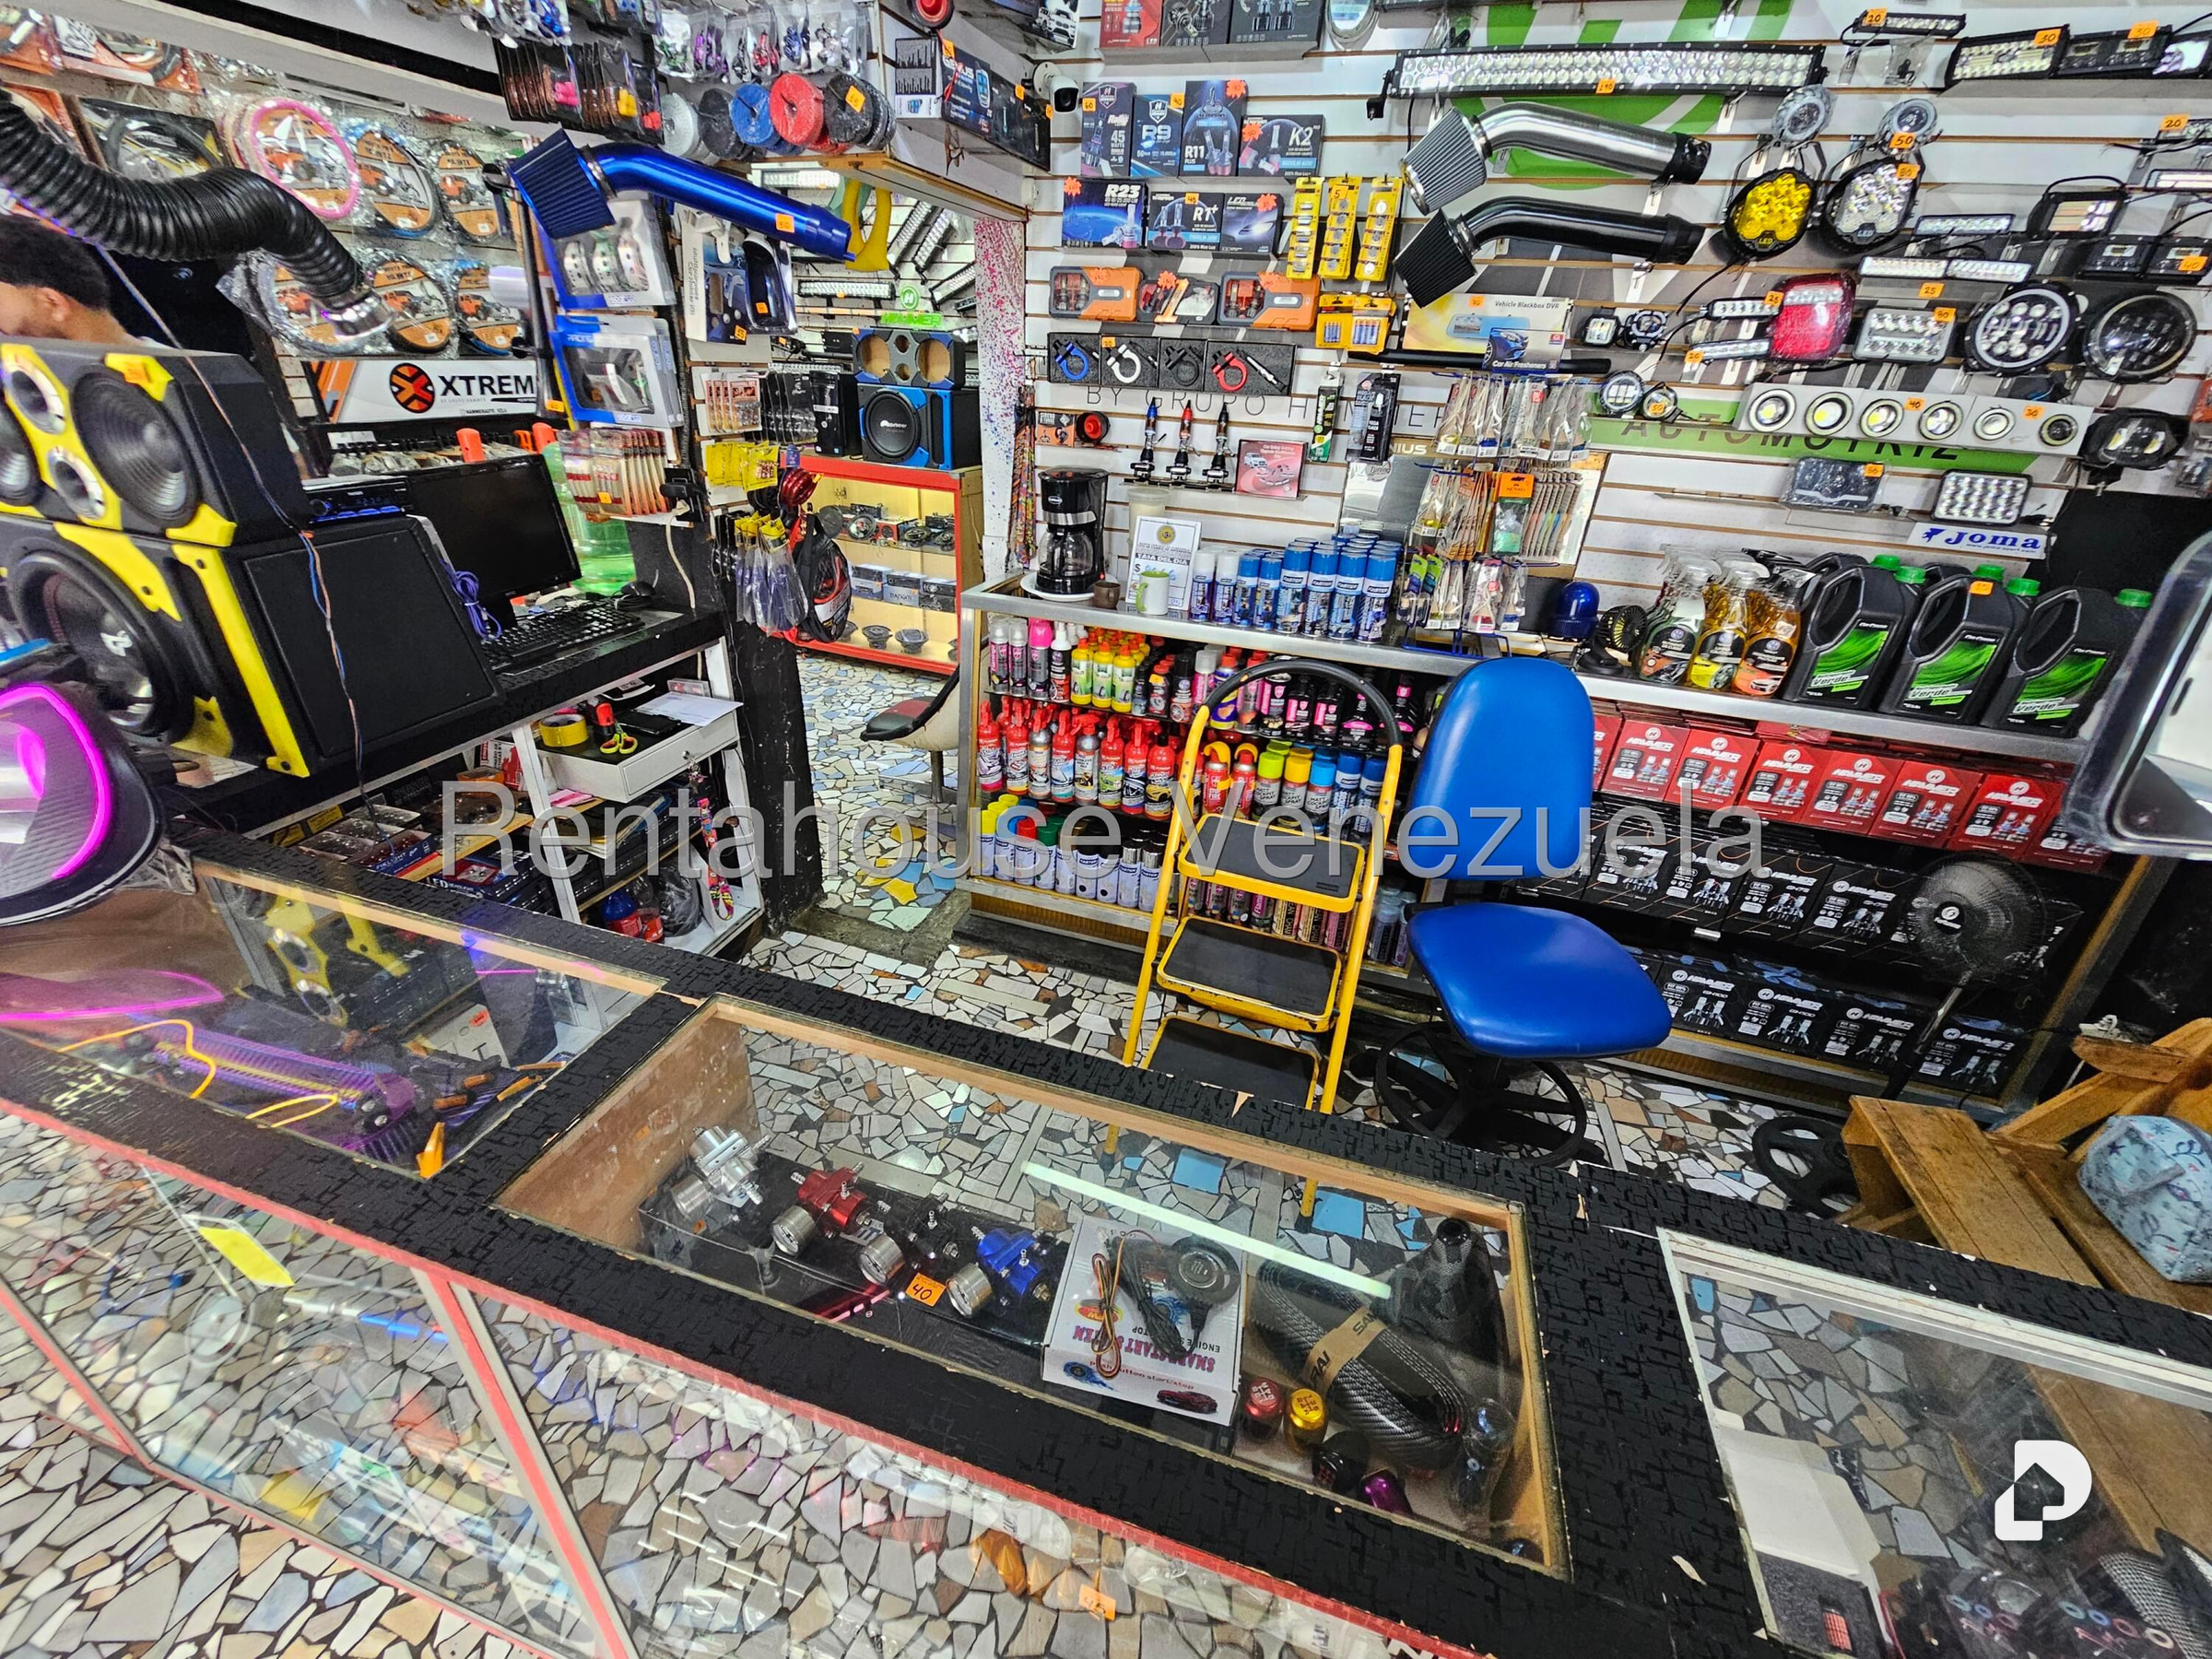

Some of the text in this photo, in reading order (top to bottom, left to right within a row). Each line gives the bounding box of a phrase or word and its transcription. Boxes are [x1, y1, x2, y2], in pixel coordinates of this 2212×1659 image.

[1111, 130, 1125, 143] 45
[1142, 124, 1171, 141] R9
[1288, 126, 1313, 147] K2
[1185, 146, 1205, 159] R11
[1104, 184, 1141, 198] R23
[1517, 300, 1545, 309] Blackbox
[1944, 531, 2041, 549] Joma
[1812, 675, 1850, 687] Verde
[1909, 688, 1951, 700] Verde
[2016, 701, 2055, 713] Verde
[911, 1284, 933, 1301] 40
